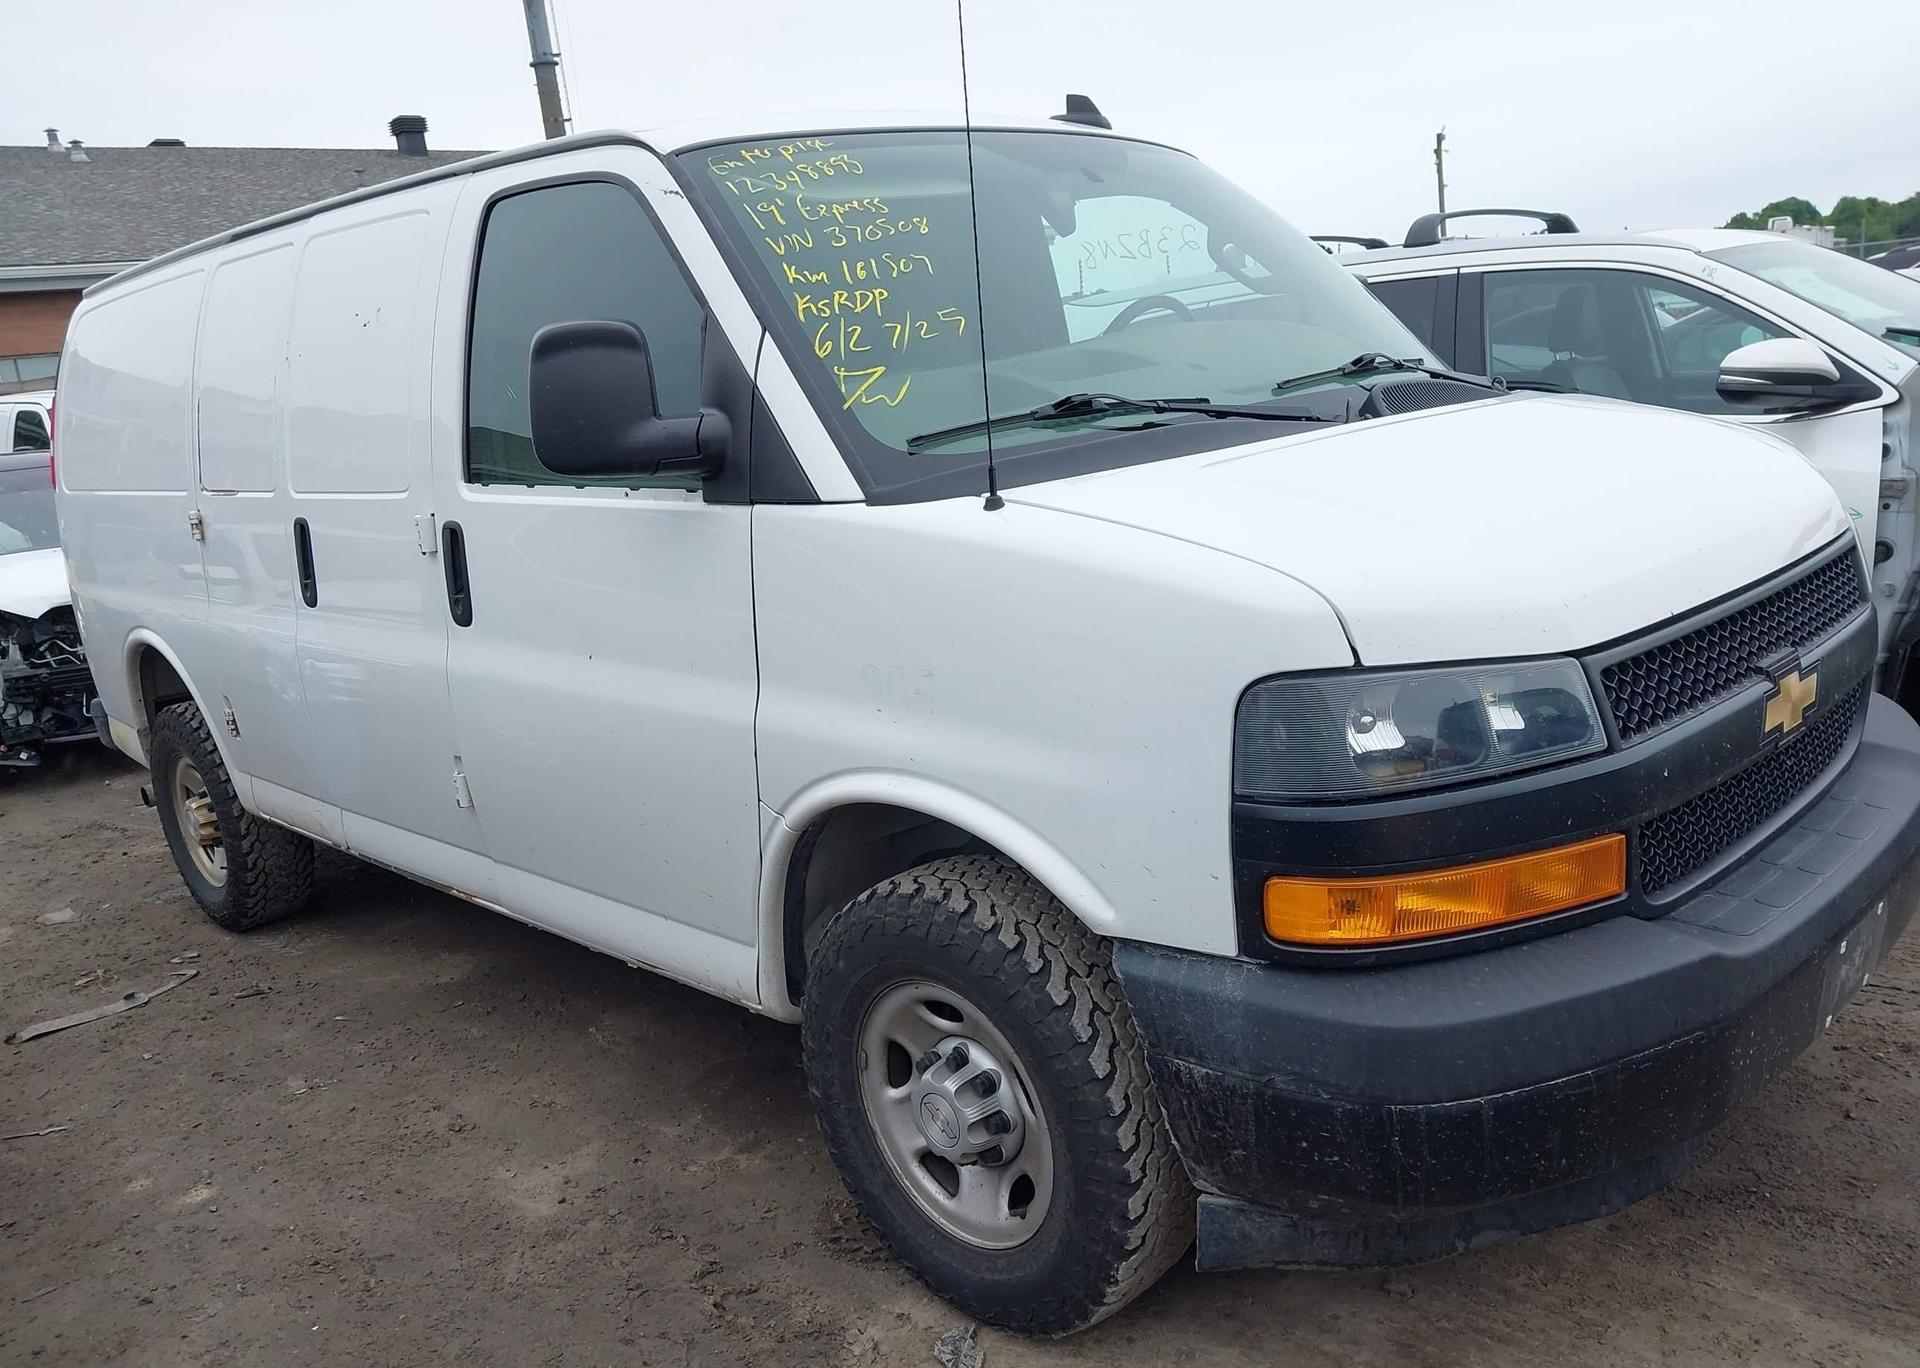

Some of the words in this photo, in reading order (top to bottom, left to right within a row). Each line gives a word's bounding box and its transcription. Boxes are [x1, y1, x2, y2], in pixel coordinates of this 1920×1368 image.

[796, 194, 889, 224] Express
[765, 228, 813, 257] VIN
[823, 217, 930, 247] 370508
